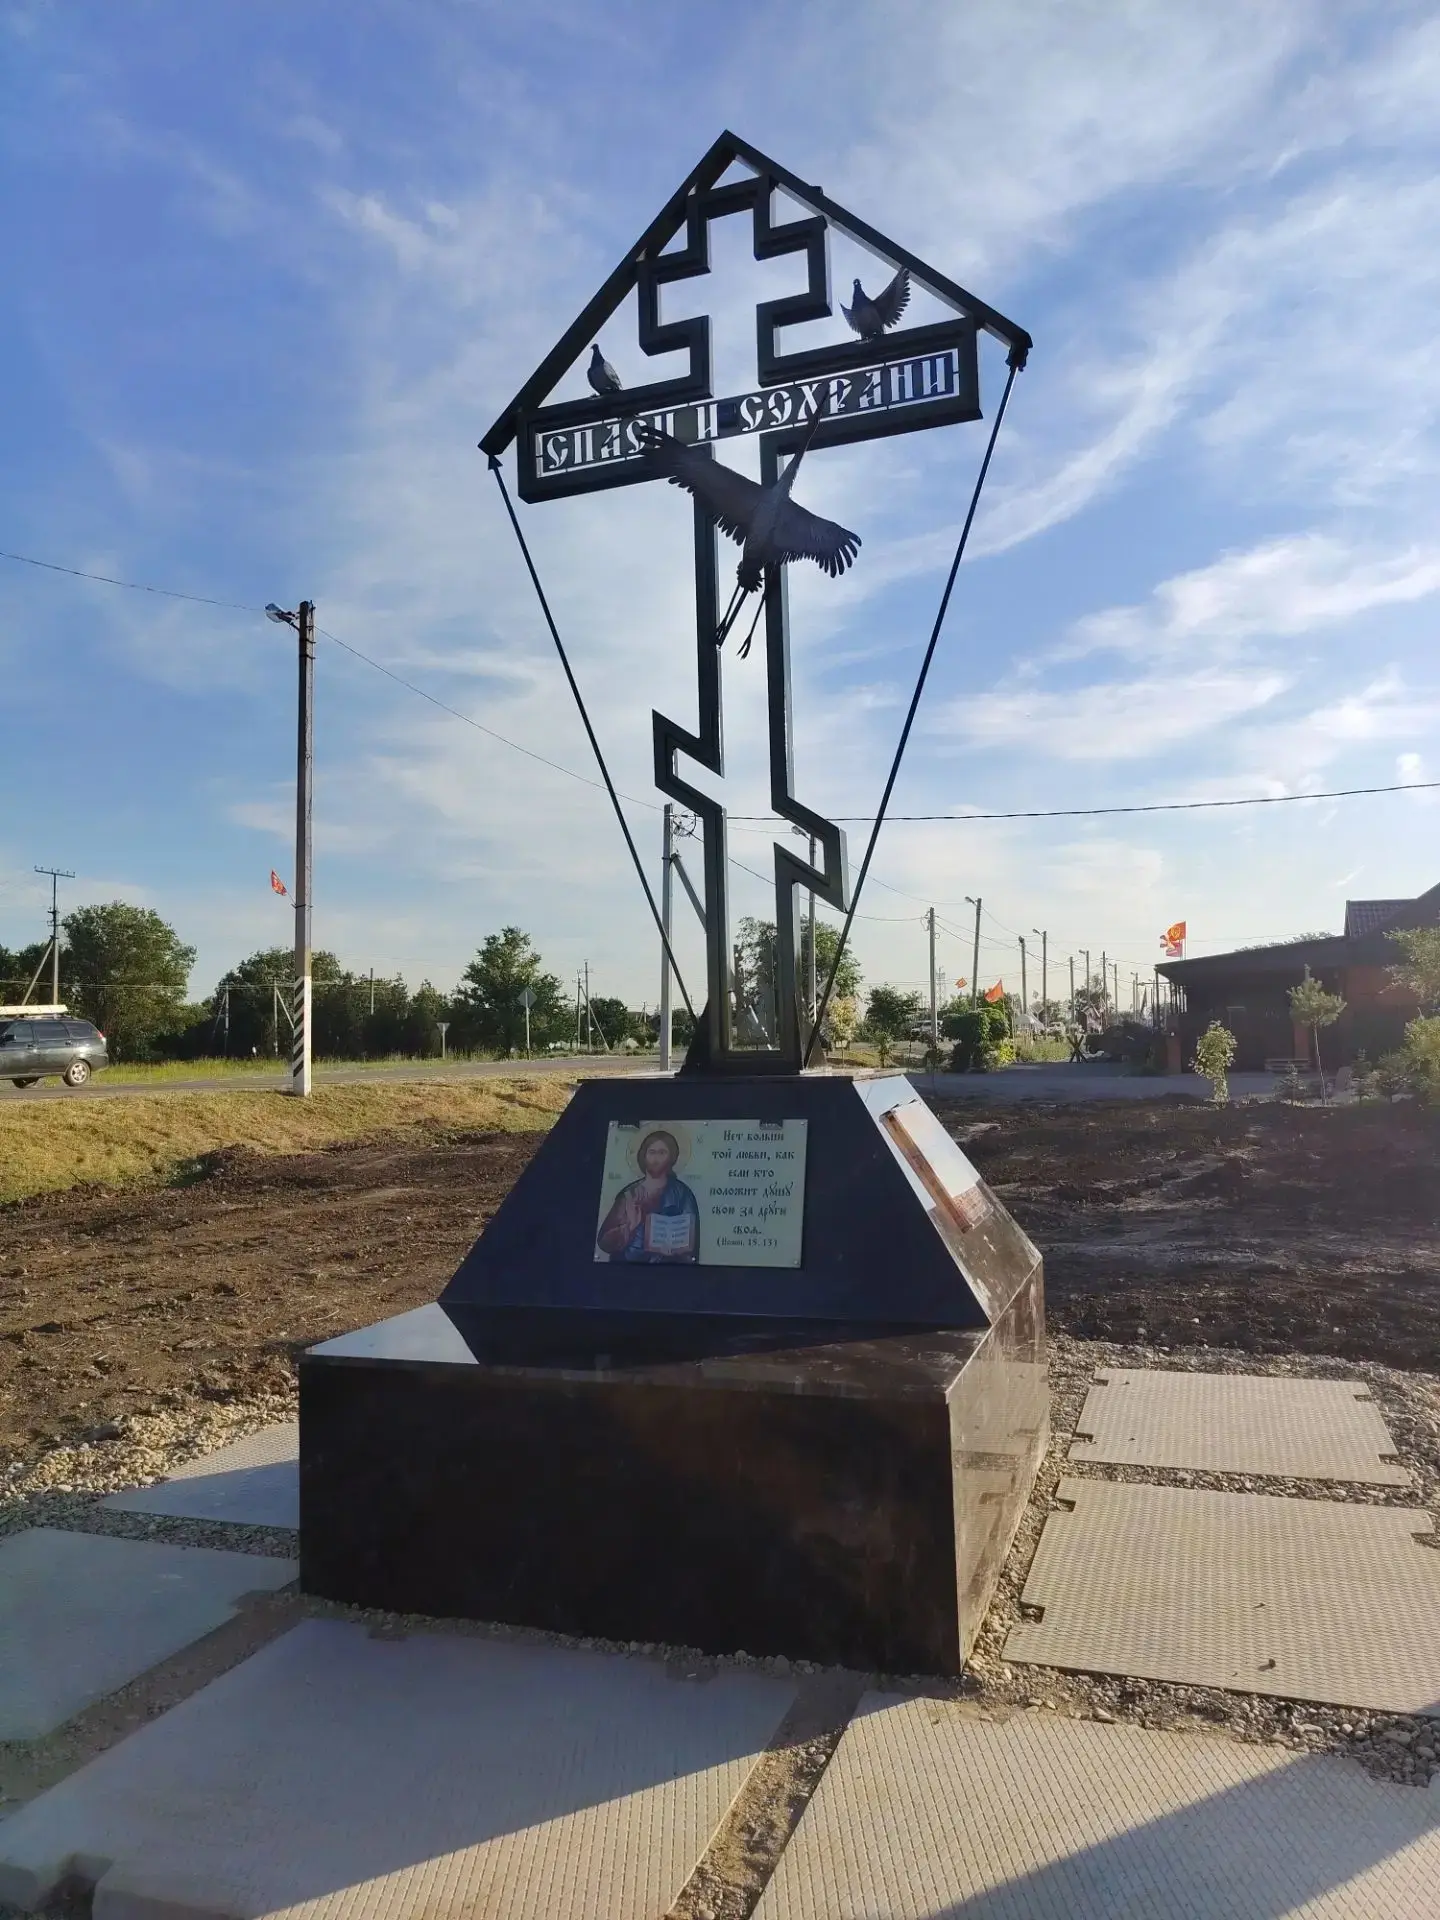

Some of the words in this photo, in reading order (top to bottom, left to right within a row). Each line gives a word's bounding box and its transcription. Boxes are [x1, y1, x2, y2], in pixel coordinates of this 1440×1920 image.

[697, 403, 719, 441] И
[740, 357, 946, 432] СОХРАНИ
[723, 1130, 743, 1141] Нет
[711, 1148, 732, 1160] той
[775, 1151, 795, 1160] как
[754, 1169, 774, 1179] кто
[709, 1187, 758, 1196] положит
